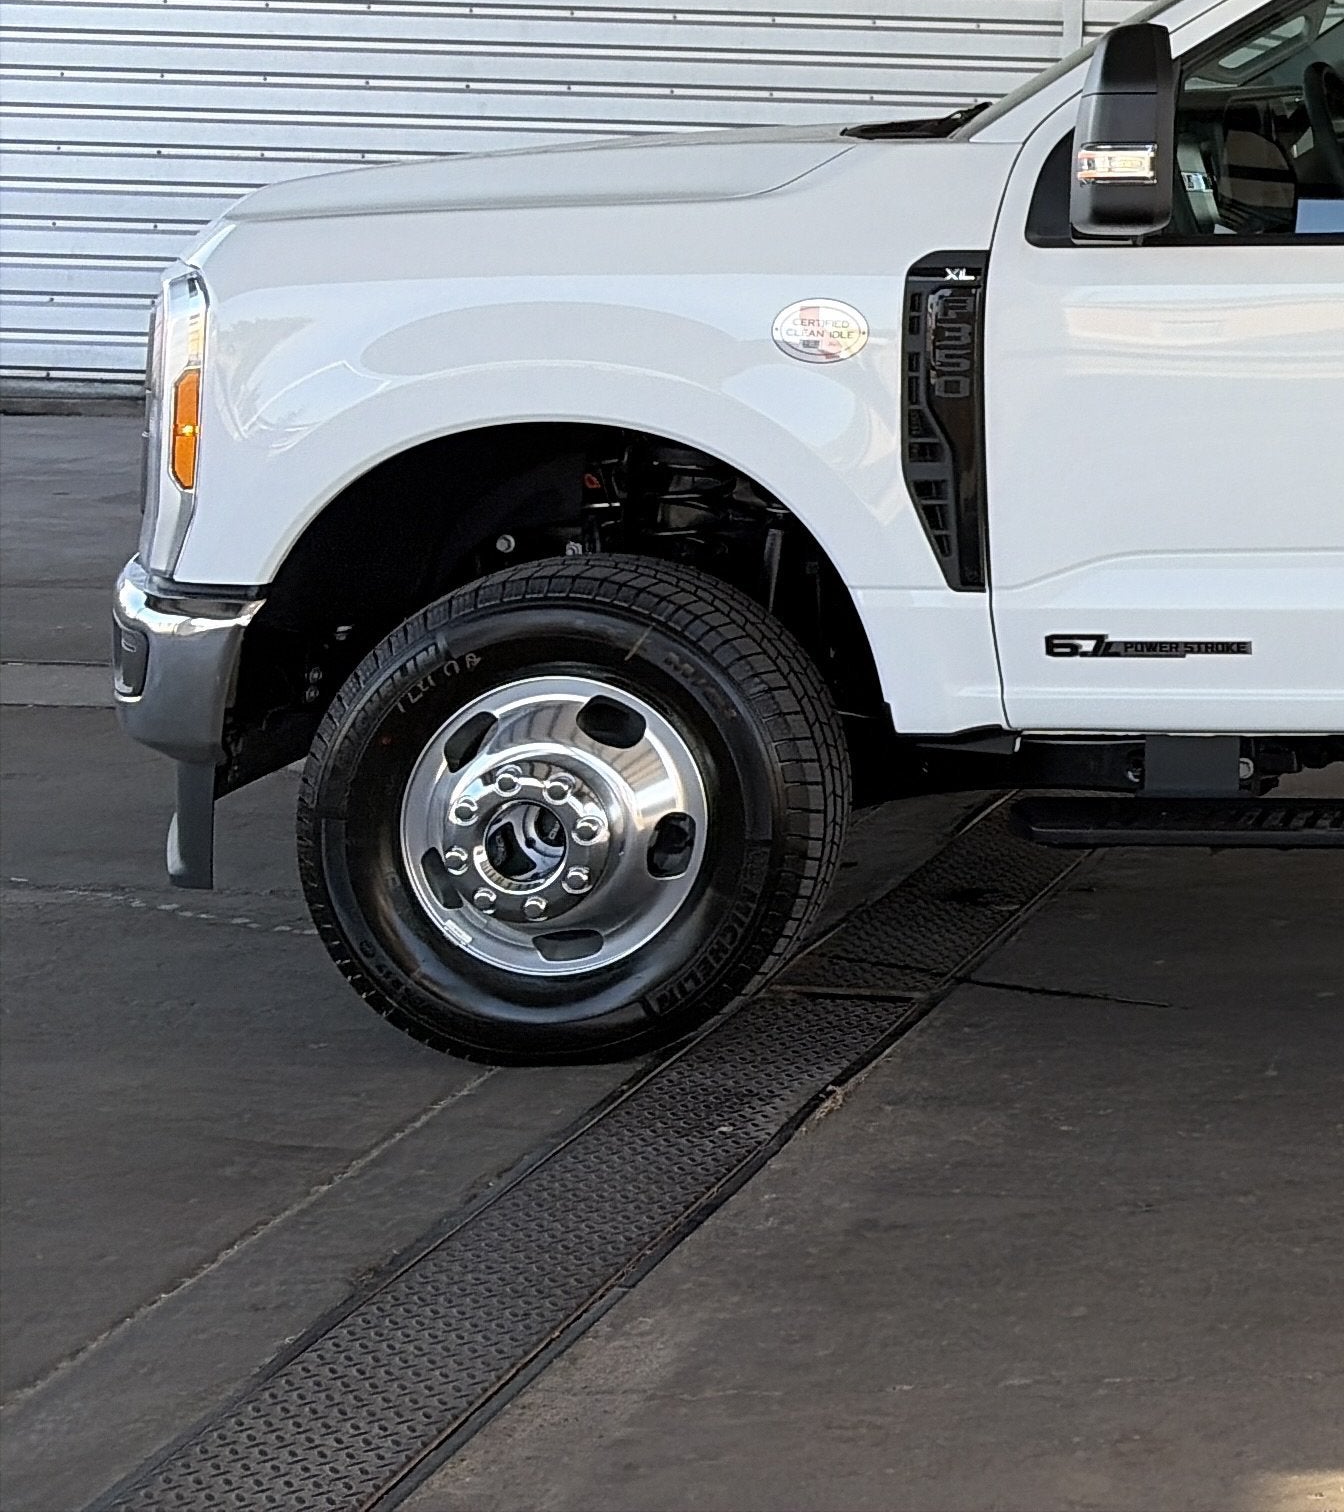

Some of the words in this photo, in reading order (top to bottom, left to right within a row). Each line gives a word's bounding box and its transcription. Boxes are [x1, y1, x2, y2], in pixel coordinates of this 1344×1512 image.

[944, 267, 976, 281] XL
[792, 318, 850, 329] CERTIFIED
[785, 328, 825, 338] CLEAN
[829, 330, 855, 339] IDLE
[1123, 642, 1185, 654] POWER
[1185, 642, 1248, 655] STROKE
